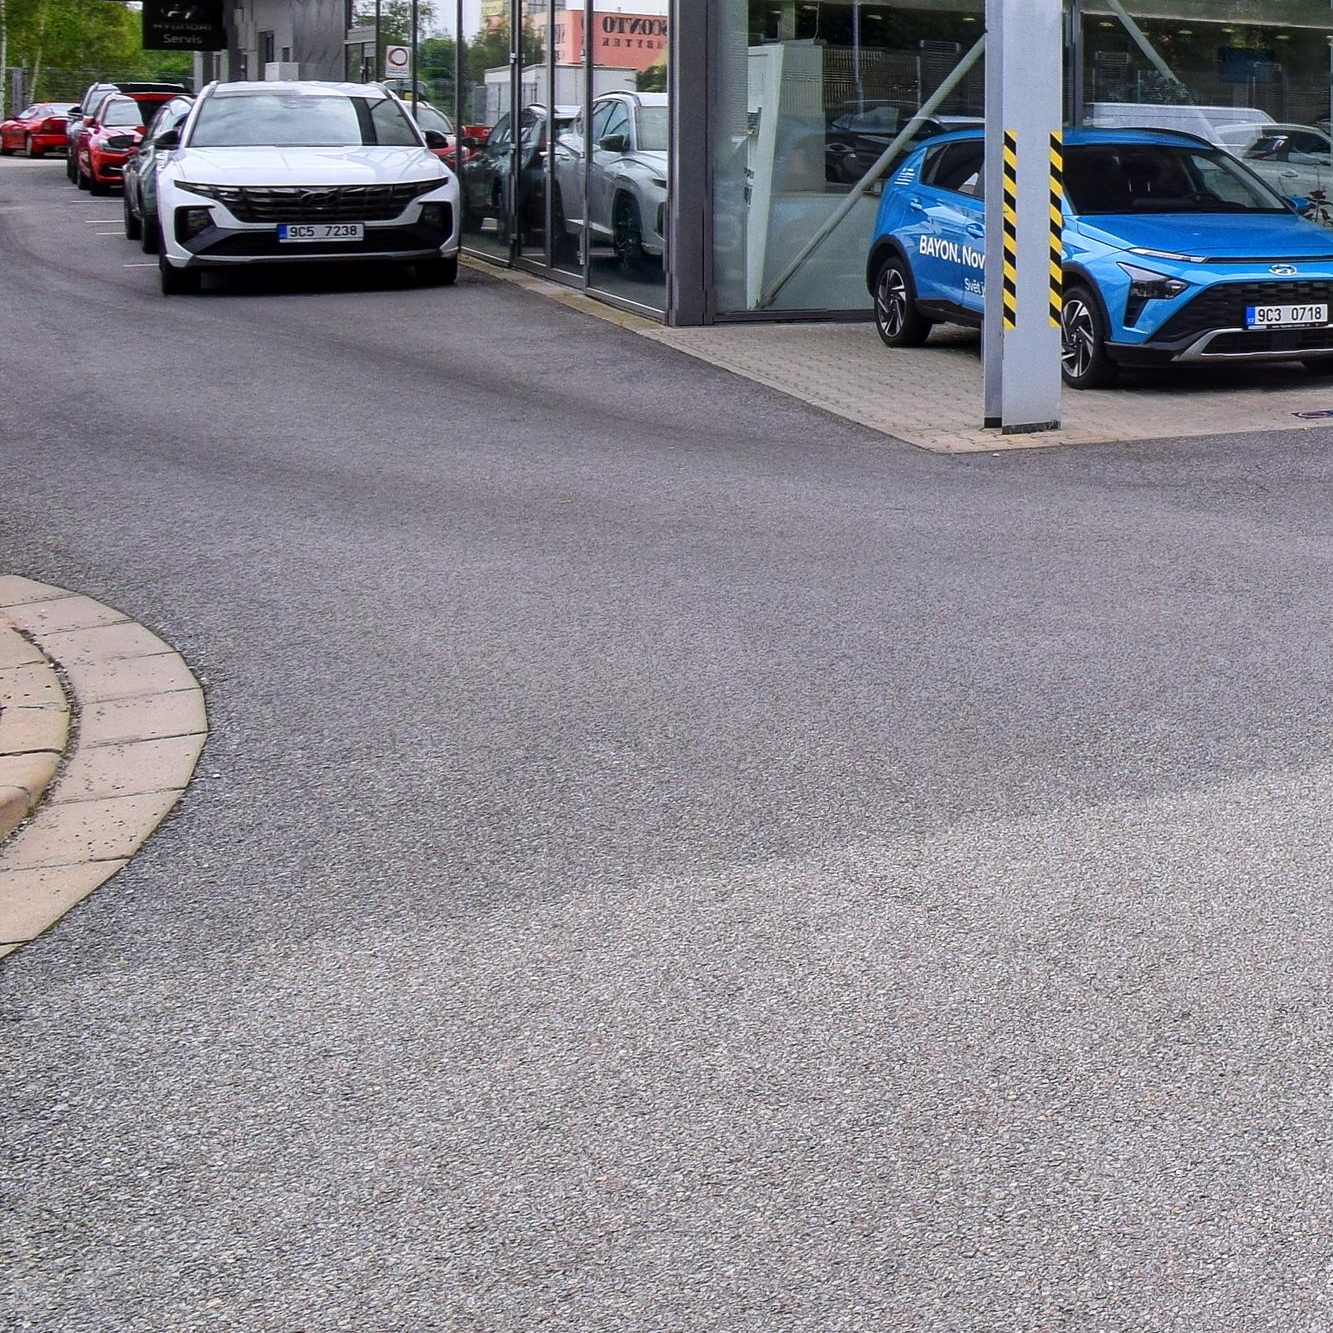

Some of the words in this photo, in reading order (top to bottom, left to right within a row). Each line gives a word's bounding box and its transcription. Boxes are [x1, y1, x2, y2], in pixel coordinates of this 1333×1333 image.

[163, 33, 202, 44] Servis
[289, 226, 315, 237] 9C5
[324, 225, 357, 236] 7238
[920, 234, 961, 263] BAYON.
[962, 245, 985, 269] Nov
[1257, 308, 1282, 322] 9C3
[1291, 306, 1322, 321] 0718
